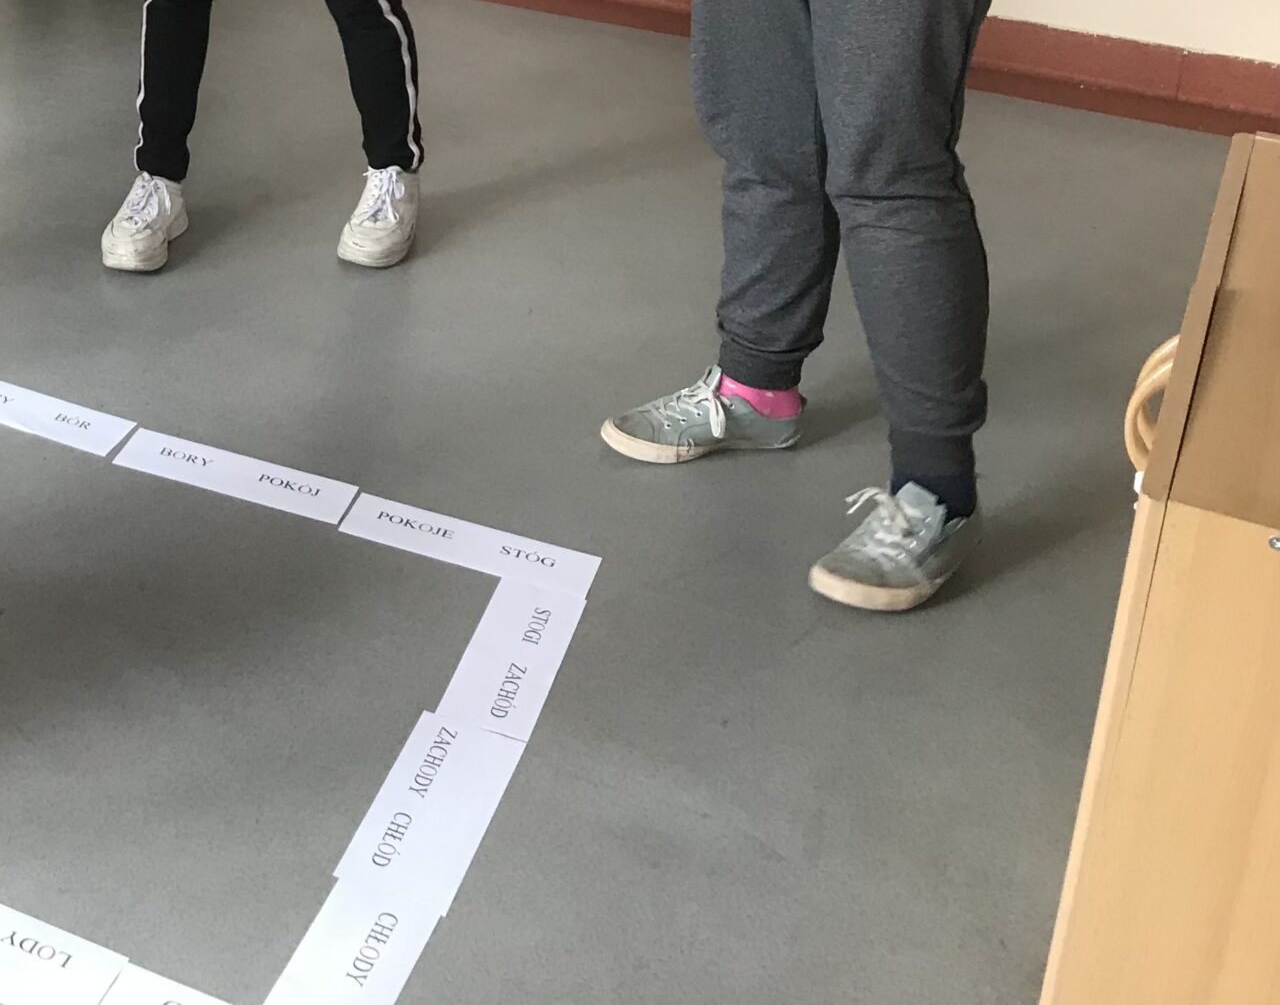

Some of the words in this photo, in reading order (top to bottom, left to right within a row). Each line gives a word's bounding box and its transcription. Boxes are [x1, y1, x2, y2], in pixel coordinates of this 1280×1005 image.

[54, 411, 92, 431] BÓR
[159, 446, 214, 468] BORY
[258, 473, 323, 497] POKÓJ
[376, 511, 456, 541] POKOJE
[500, 544, 556, 569] STÓG
[521, 607, 552, 647] STOGI
[490, 662, 527, 720] ZACHÓD
[409, 726, 458, 800] ZACHODY
[371, 811, 413, 868] CHŁÓD
[0, 930, 73, 969] LODY
[346, 911, 399, 987] CHŁODY
